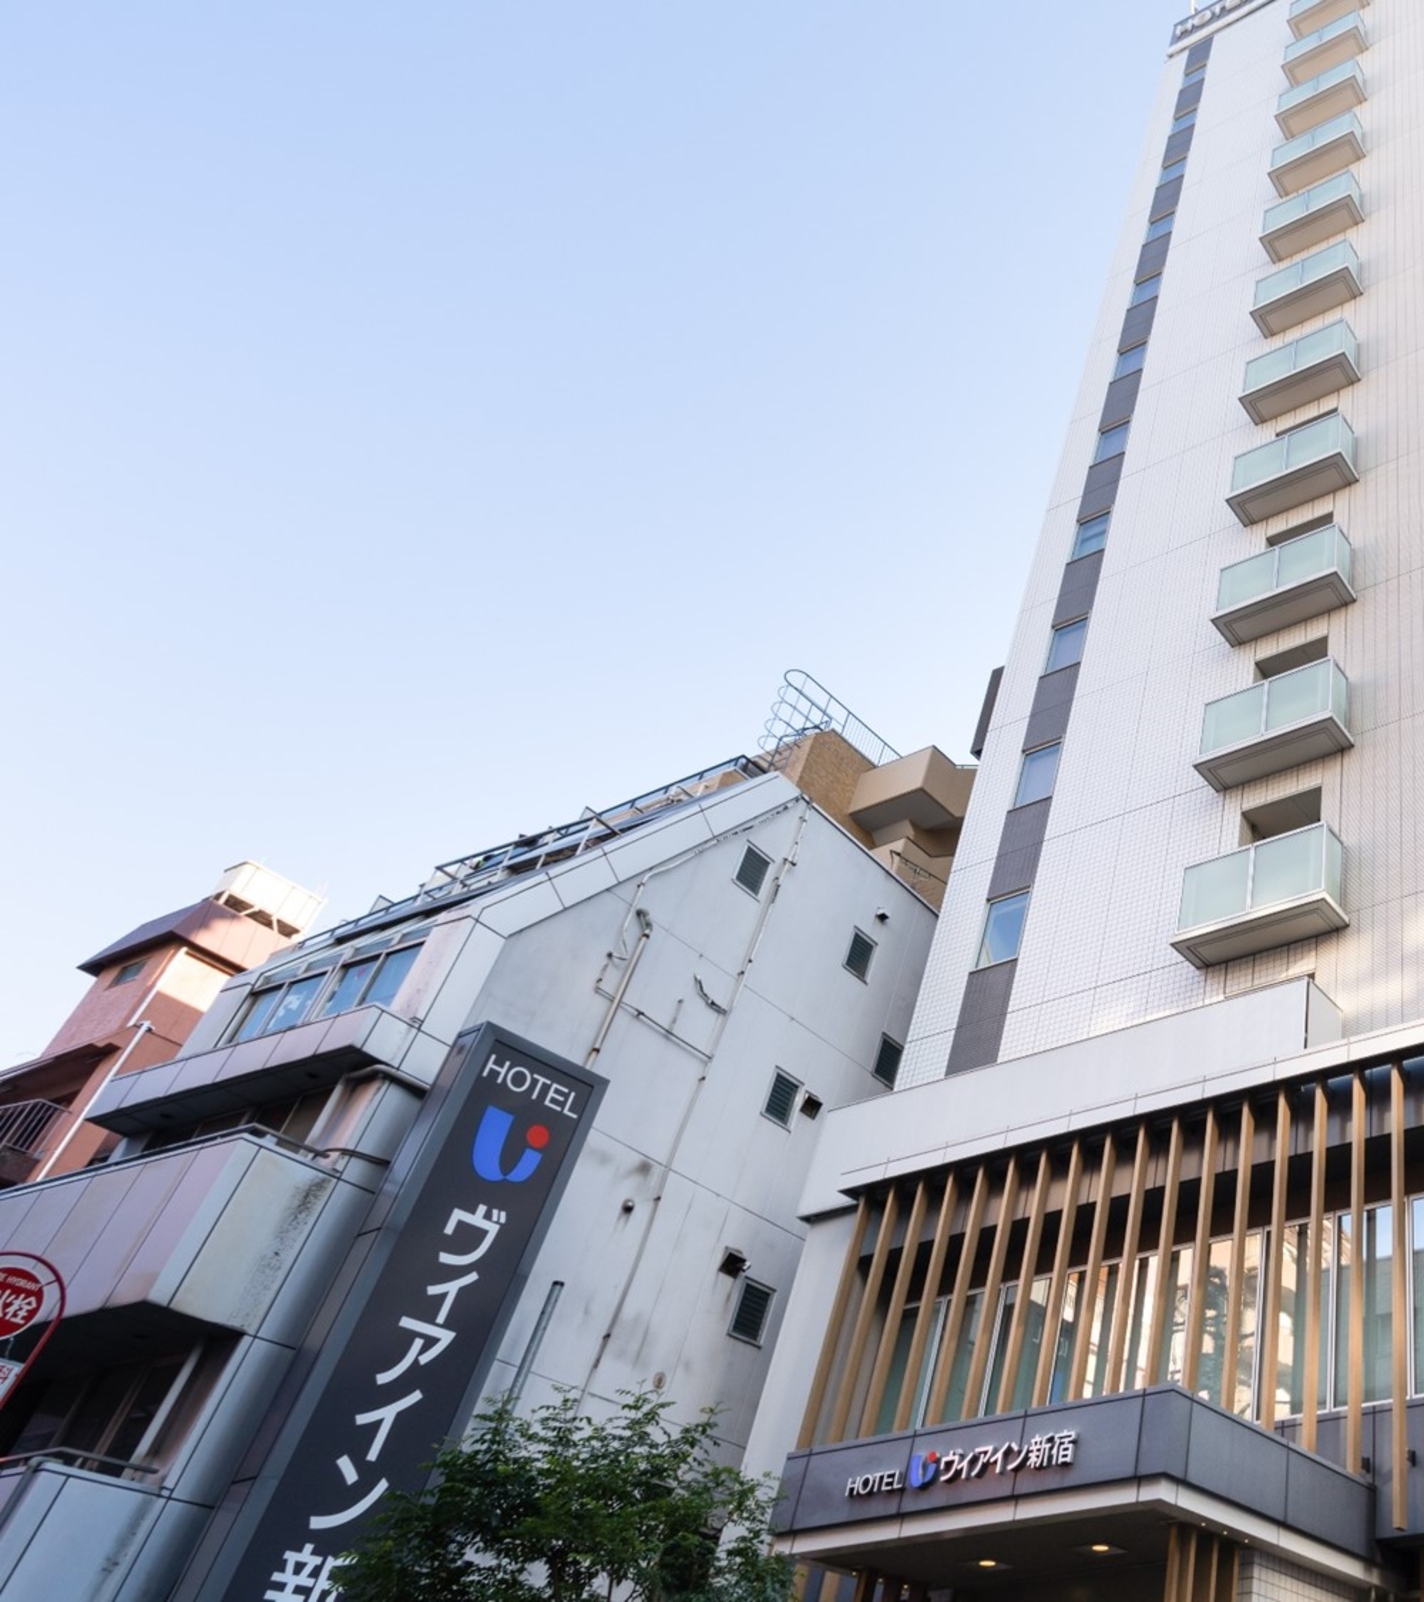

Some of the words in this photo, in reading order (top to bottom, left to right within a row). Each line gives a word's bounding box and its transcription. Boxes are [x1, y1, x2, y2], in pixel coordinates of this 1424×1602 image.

[481, 1054, 580, 1119] HOTEL
[845, 1470, 903, 1497] HOTEL
[939, 1429, 1077, 1483] ヴィアイン新宿
